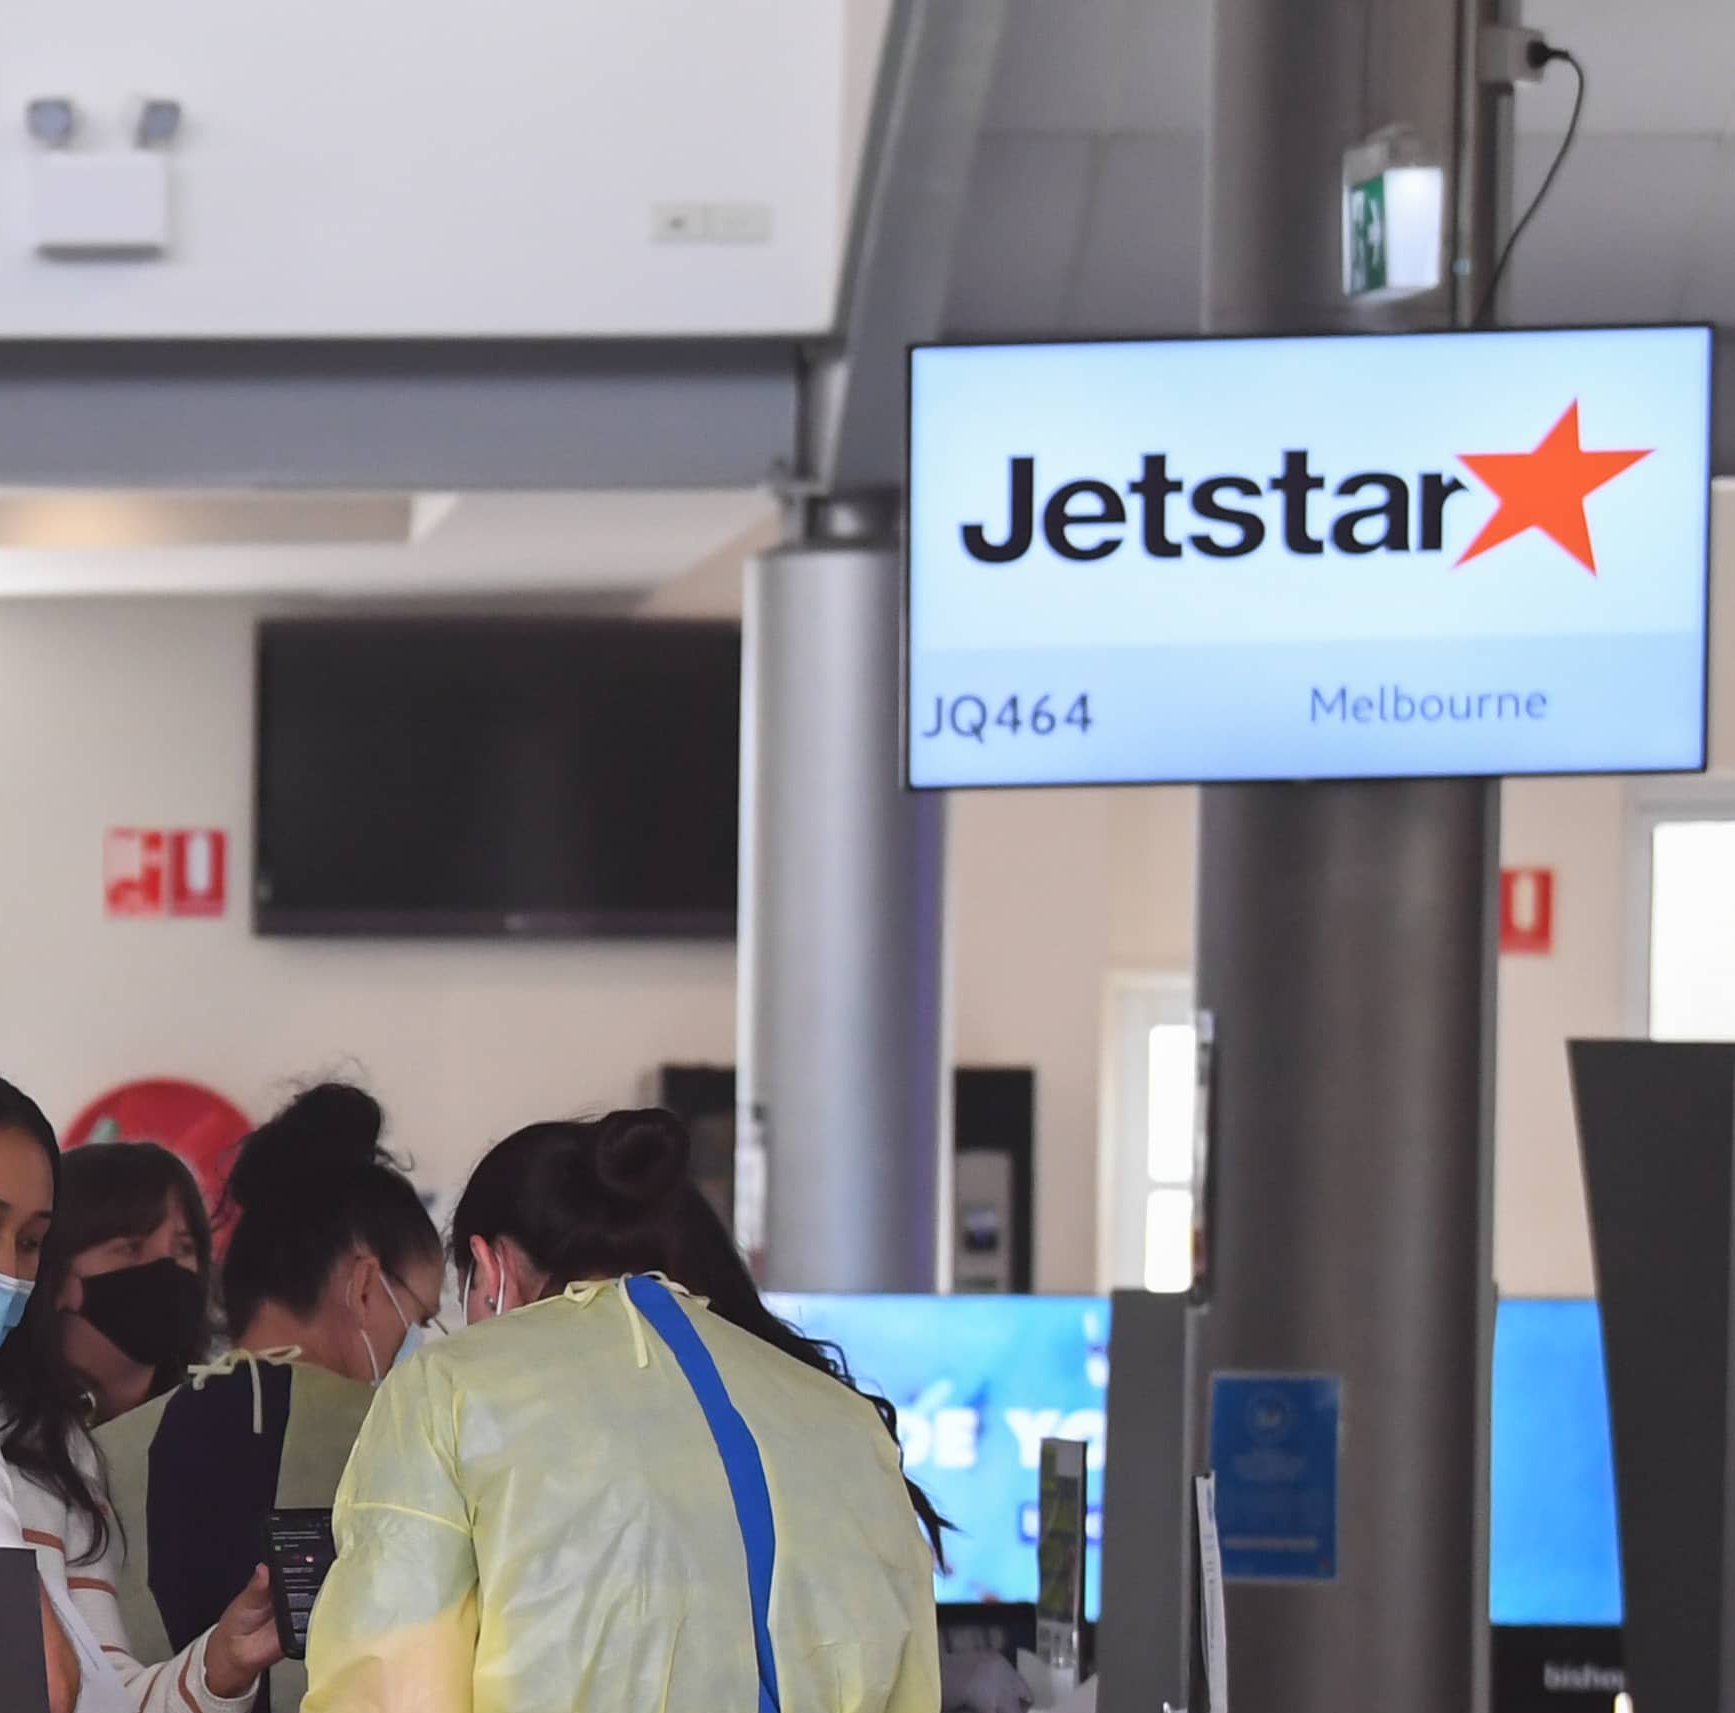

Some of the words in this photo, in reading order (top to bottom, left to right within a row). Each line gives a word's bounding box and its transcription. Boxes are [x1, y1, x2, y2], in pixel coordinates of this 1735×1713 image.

[961, 449, 1469, 562] Jetstar
[923, 691, 1093, 744] JQ464
[1310, 684, 1548, 724] Melbourne
